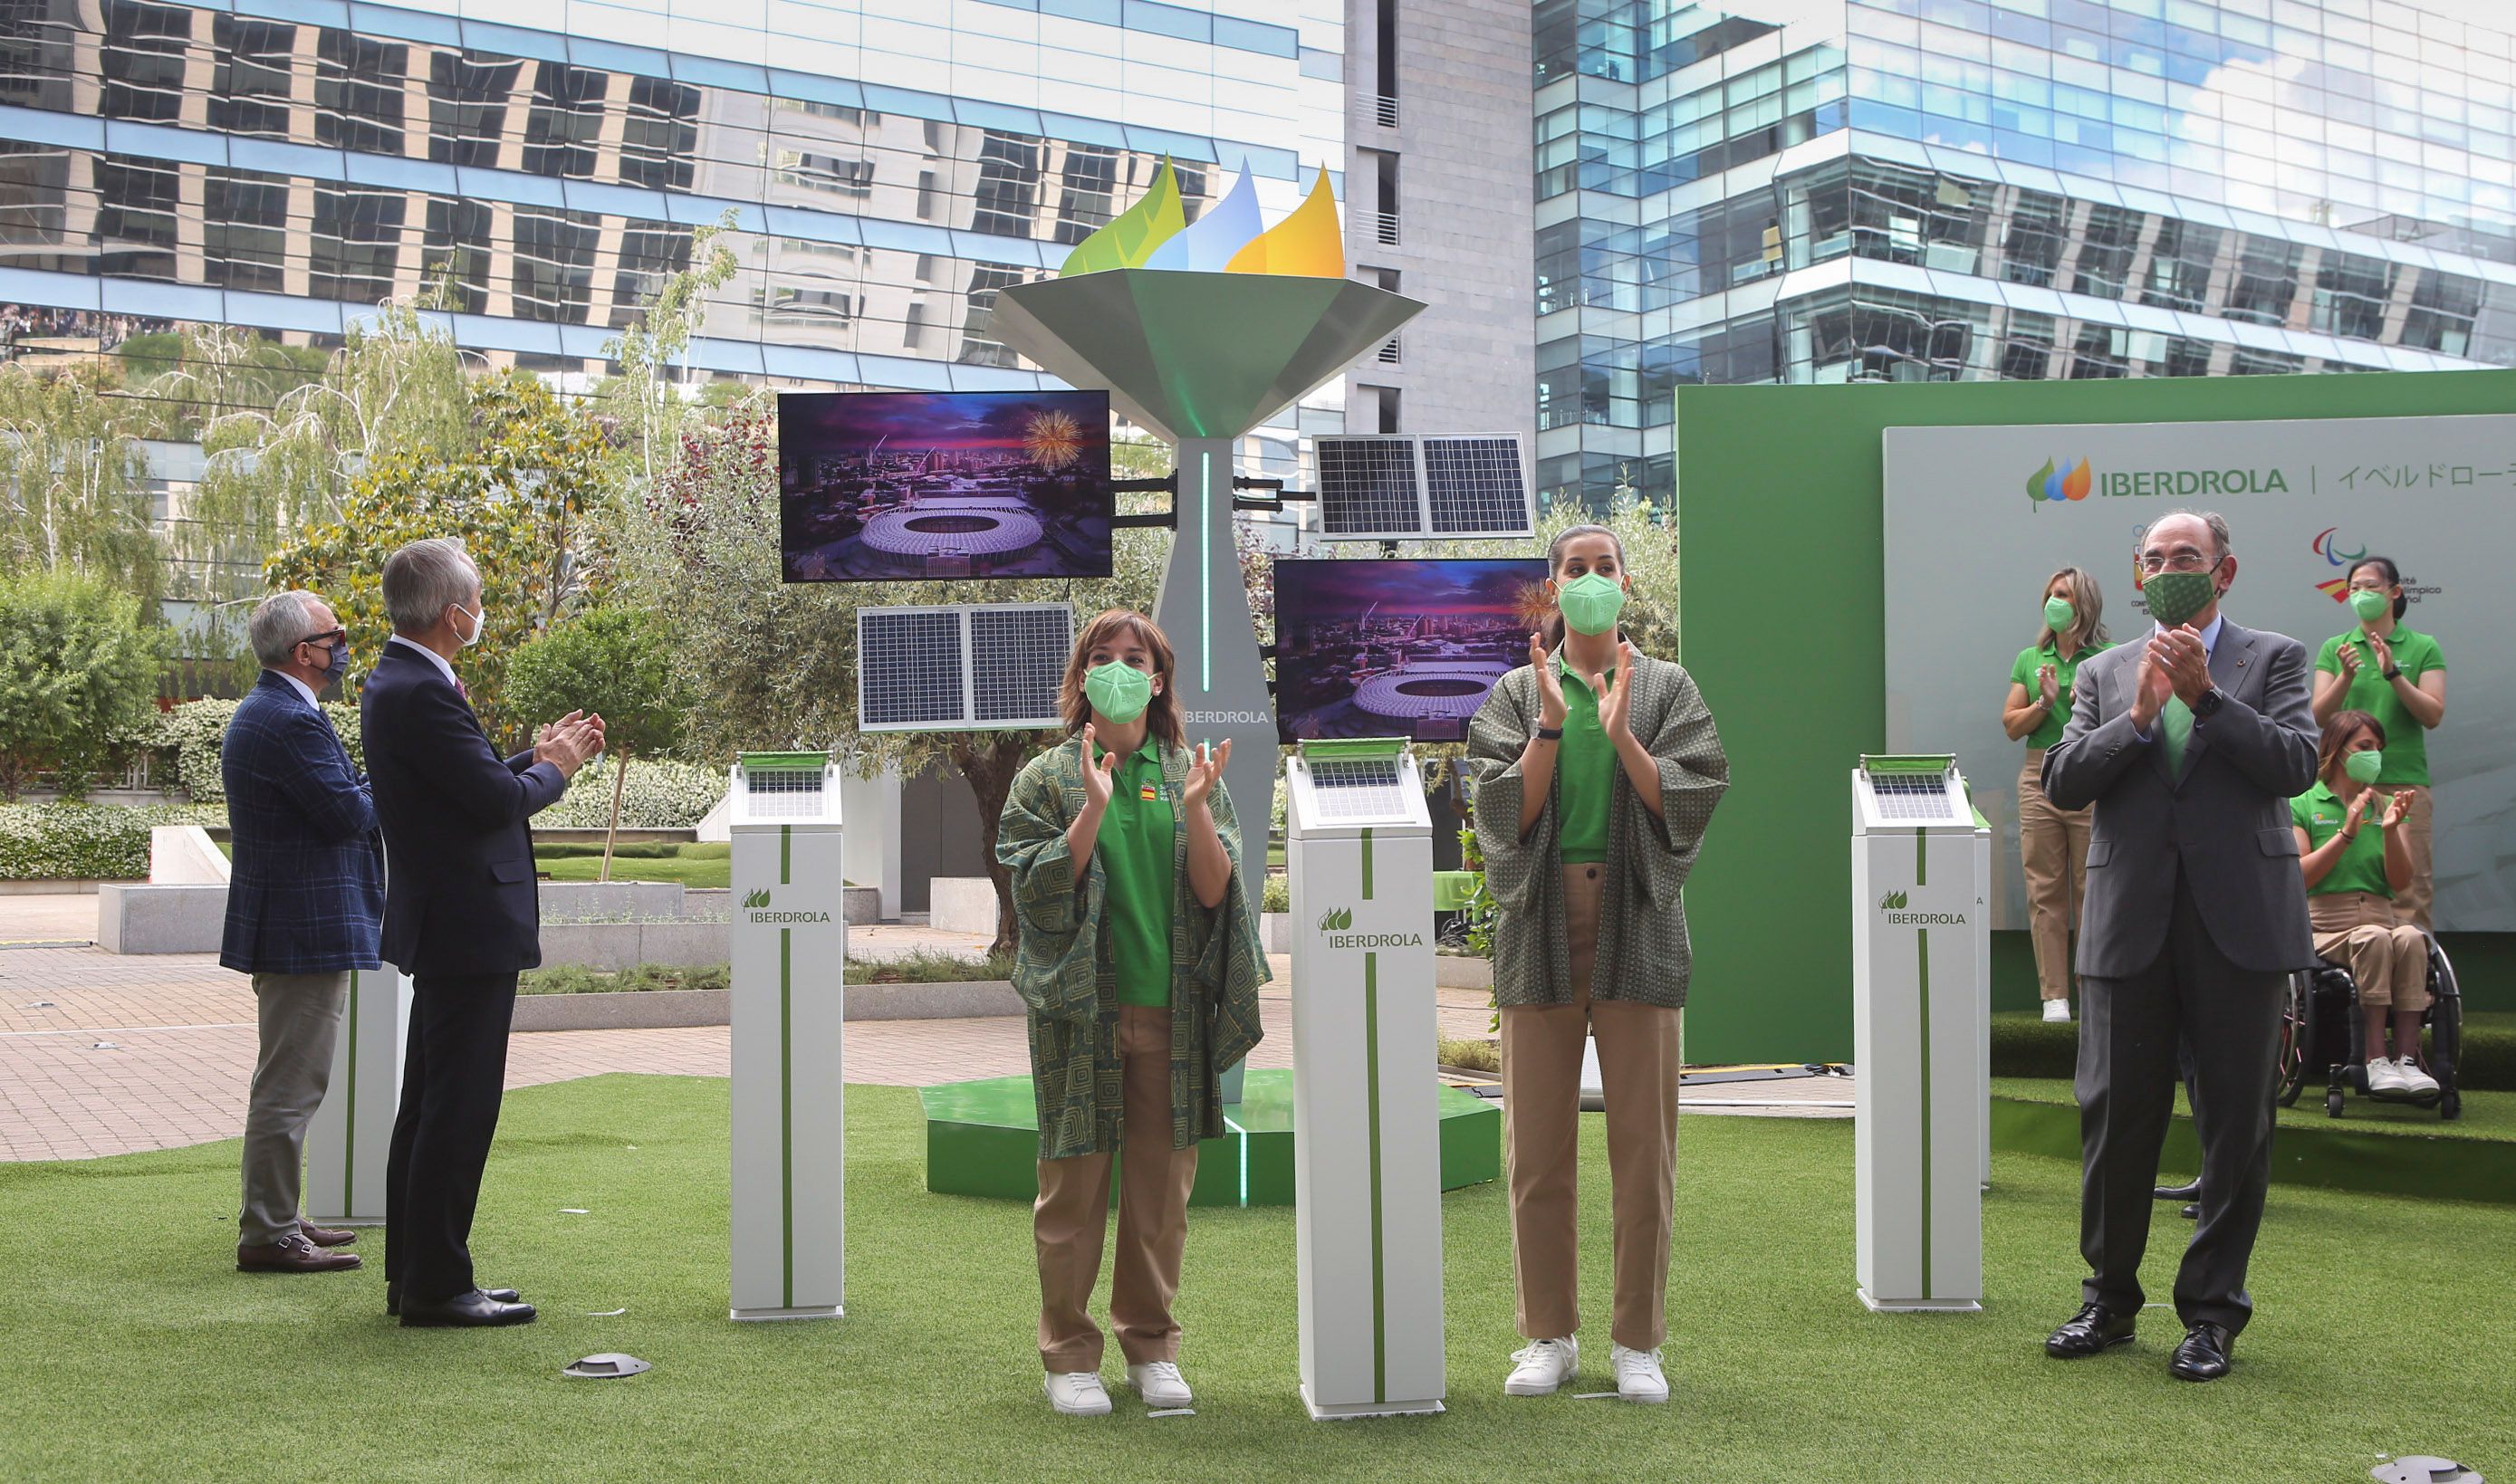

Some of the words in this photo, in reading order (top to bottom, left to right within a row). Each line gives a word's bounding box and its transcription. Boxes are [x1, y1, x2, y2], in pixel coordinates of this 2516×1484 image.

[2100, 468, 2289, 497] IBERDROLA
[1184, 711, 1269, 724] BERDROLA
[750, 911, 831, 924] IBERDROLA
[1887, 913, 1966, 924] IBERDROLA
[1329, 933, 1423, 949] IBERDROLA
